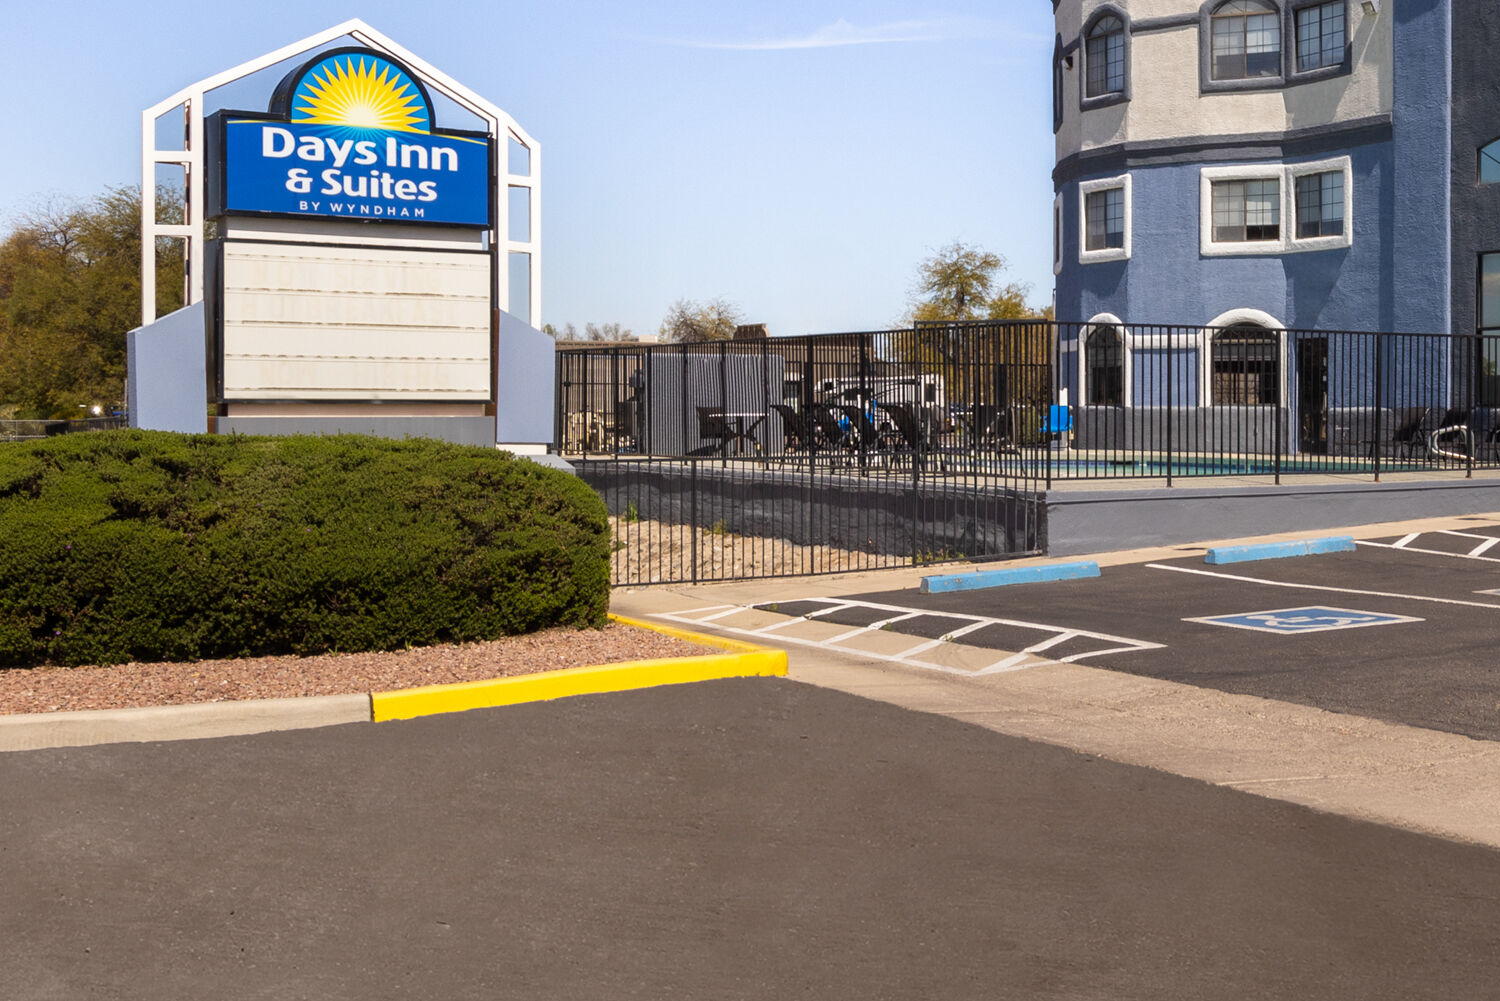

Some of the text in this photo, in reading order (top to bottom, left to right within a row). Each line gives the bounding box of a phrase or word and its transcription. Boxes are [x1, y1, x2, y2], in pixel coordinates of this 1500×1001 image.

[262, 126, 458, 171] Days Inn
[285, 168, 437, 201] & Suites
[300, 201, 425, 217] BY WYNDHAM
